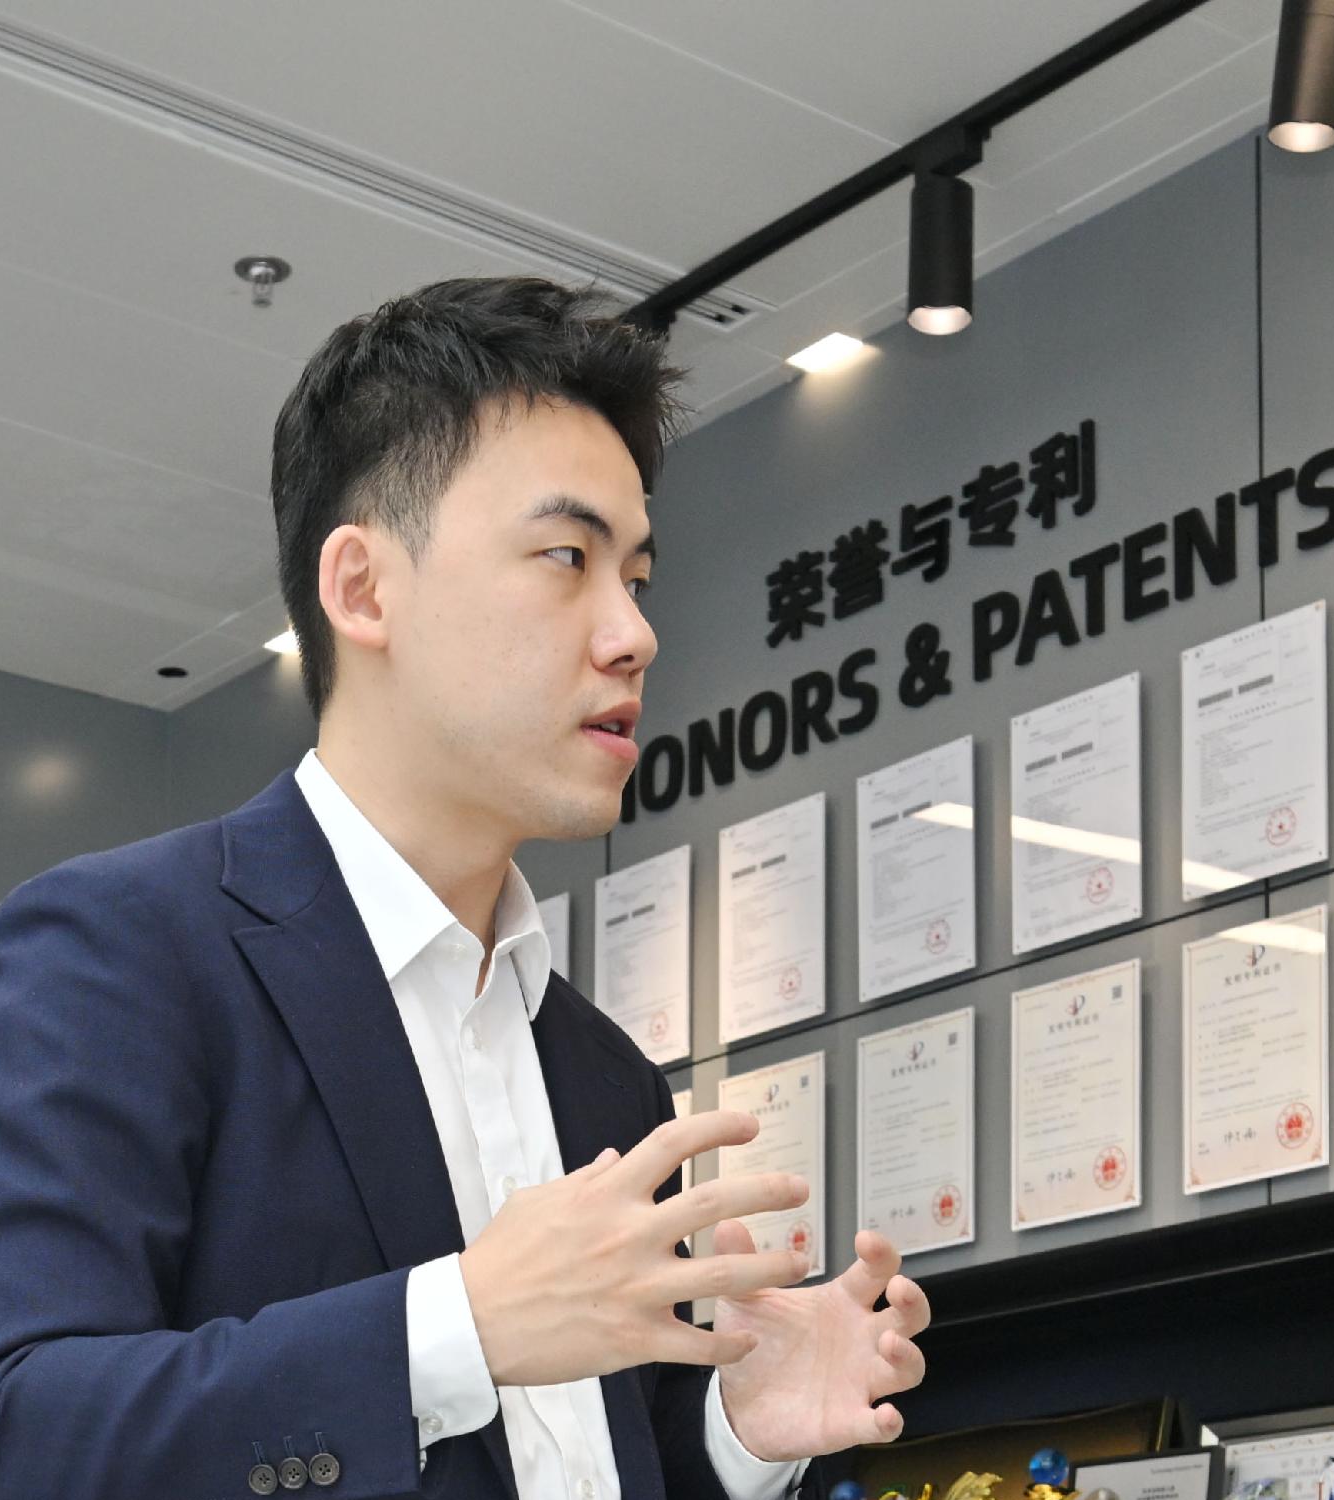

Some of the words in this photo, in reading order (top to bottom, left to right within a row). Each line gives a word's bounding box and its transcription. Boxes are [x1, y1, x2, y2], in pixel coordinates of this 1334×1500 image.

[766, 419, 1097, 648] 荣誉与专利
[620, 647, 880, 824] ONORS
[898, 622, 953, 709] &
